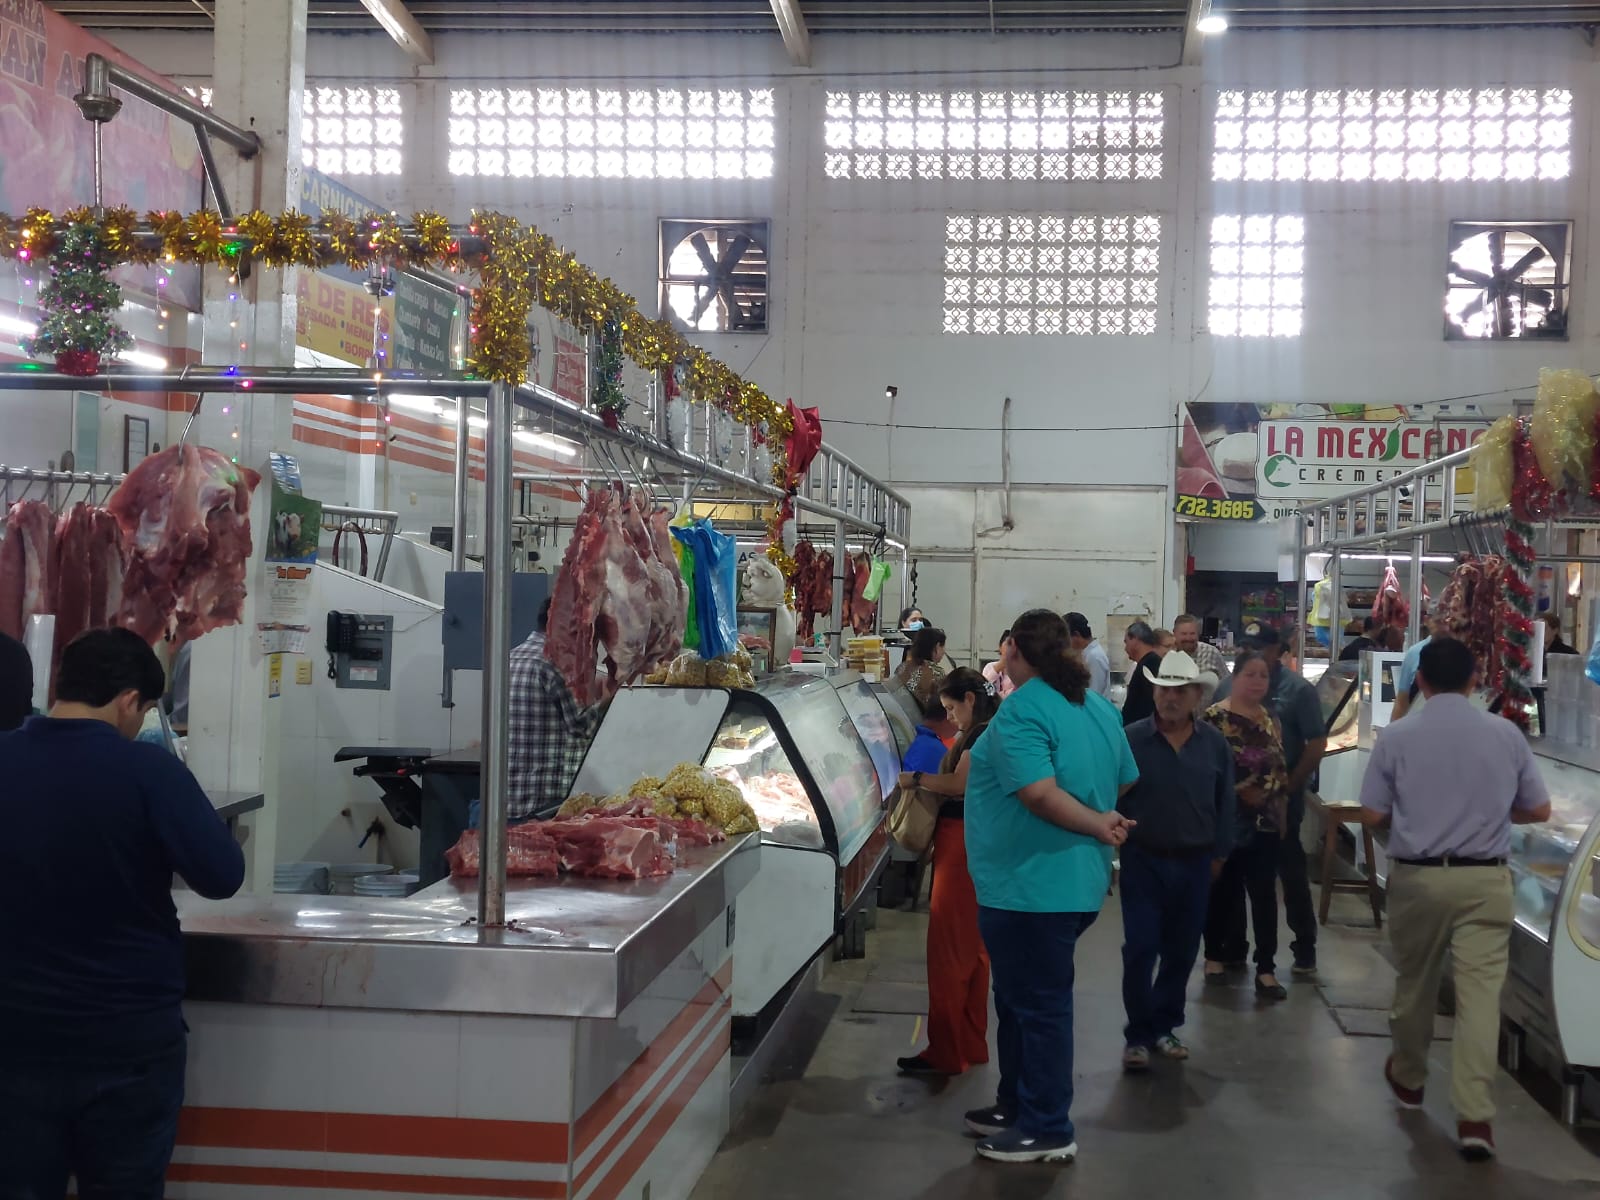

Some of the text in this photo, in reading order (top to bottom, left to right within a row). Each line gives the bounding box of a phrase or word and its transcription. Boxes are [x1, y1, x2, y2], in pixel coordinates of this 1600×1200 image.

[318, 282, 345, 316] DE
[352, 296, 389, 333] RES
[1267, 425, 1303, 458] LA
[1175, 494, 1254, 520] 732.3685
